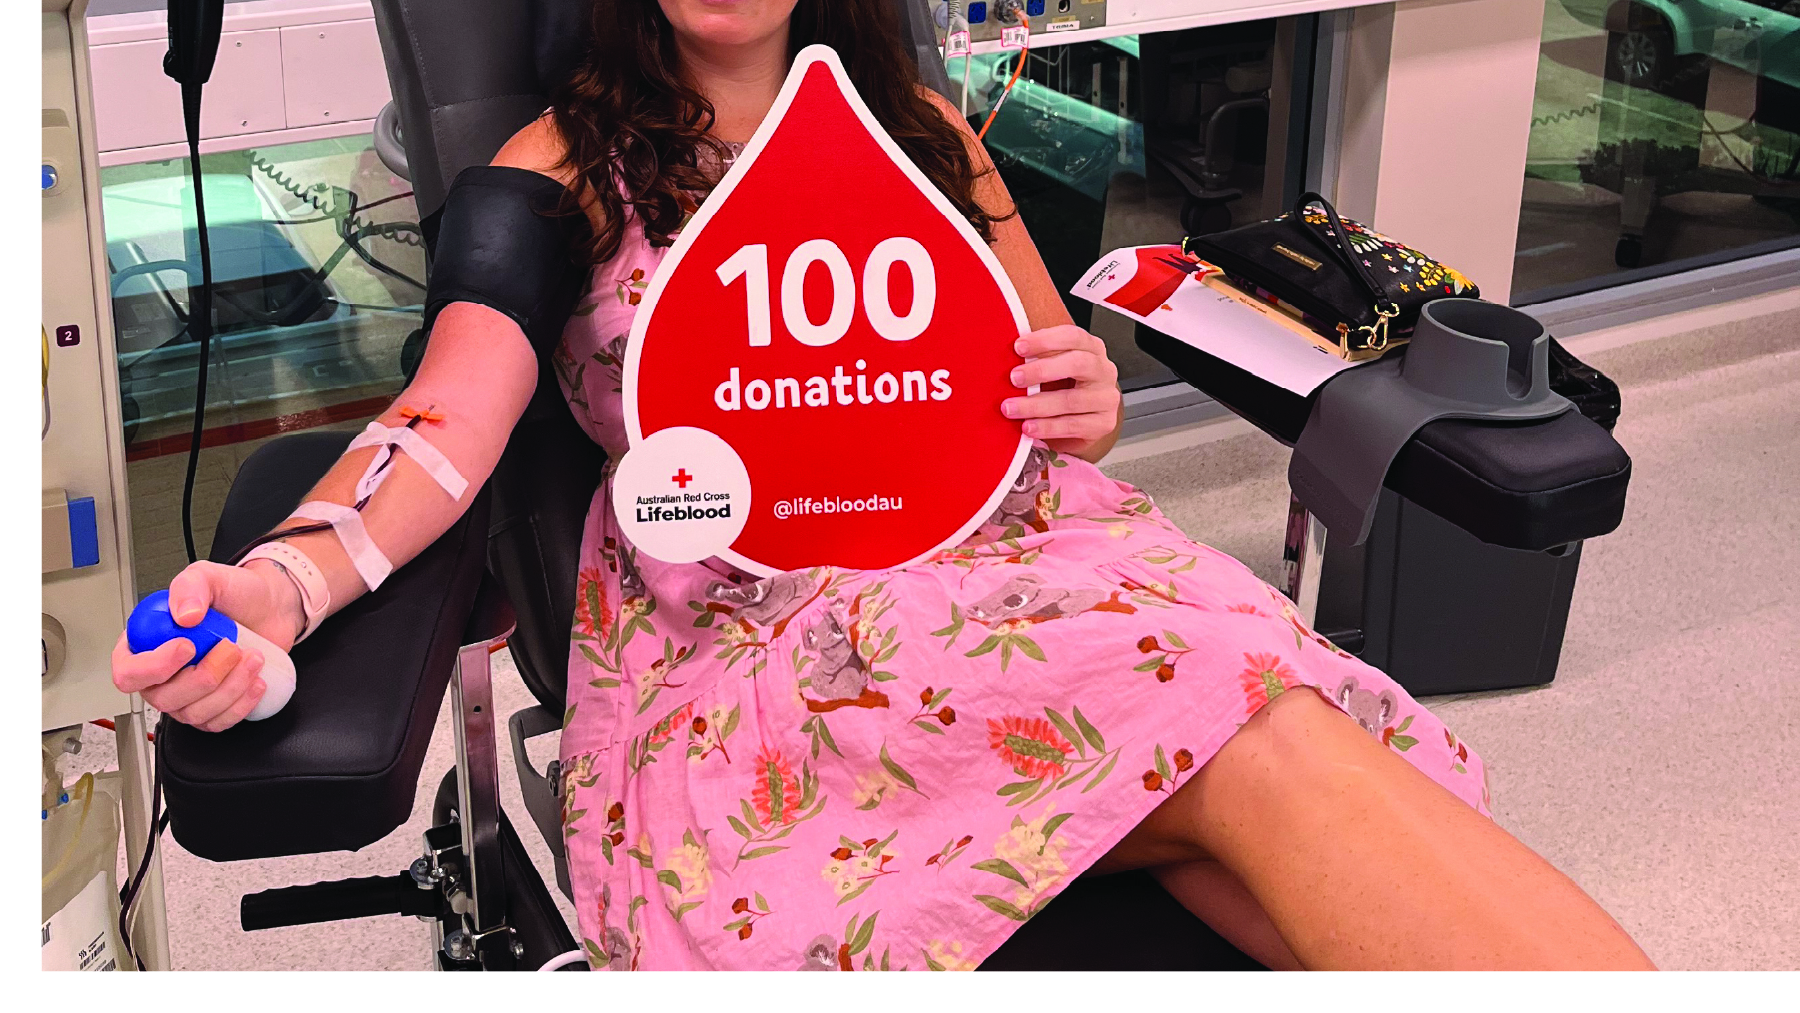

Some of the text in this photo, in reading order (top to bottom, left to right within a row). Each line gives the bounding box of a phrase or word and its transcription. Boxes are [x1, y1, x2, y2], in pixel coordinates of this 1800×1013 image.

[714, 235, 937, 348] 100
[65, 330, 73, 341] 2
[714, 359, 953, 412] donations
[636, 491, 731, 505] Australian Red Cross
[772, 493, 904, 520] @lifebloodau
[635, 502, 731, 523] Lifeblood
